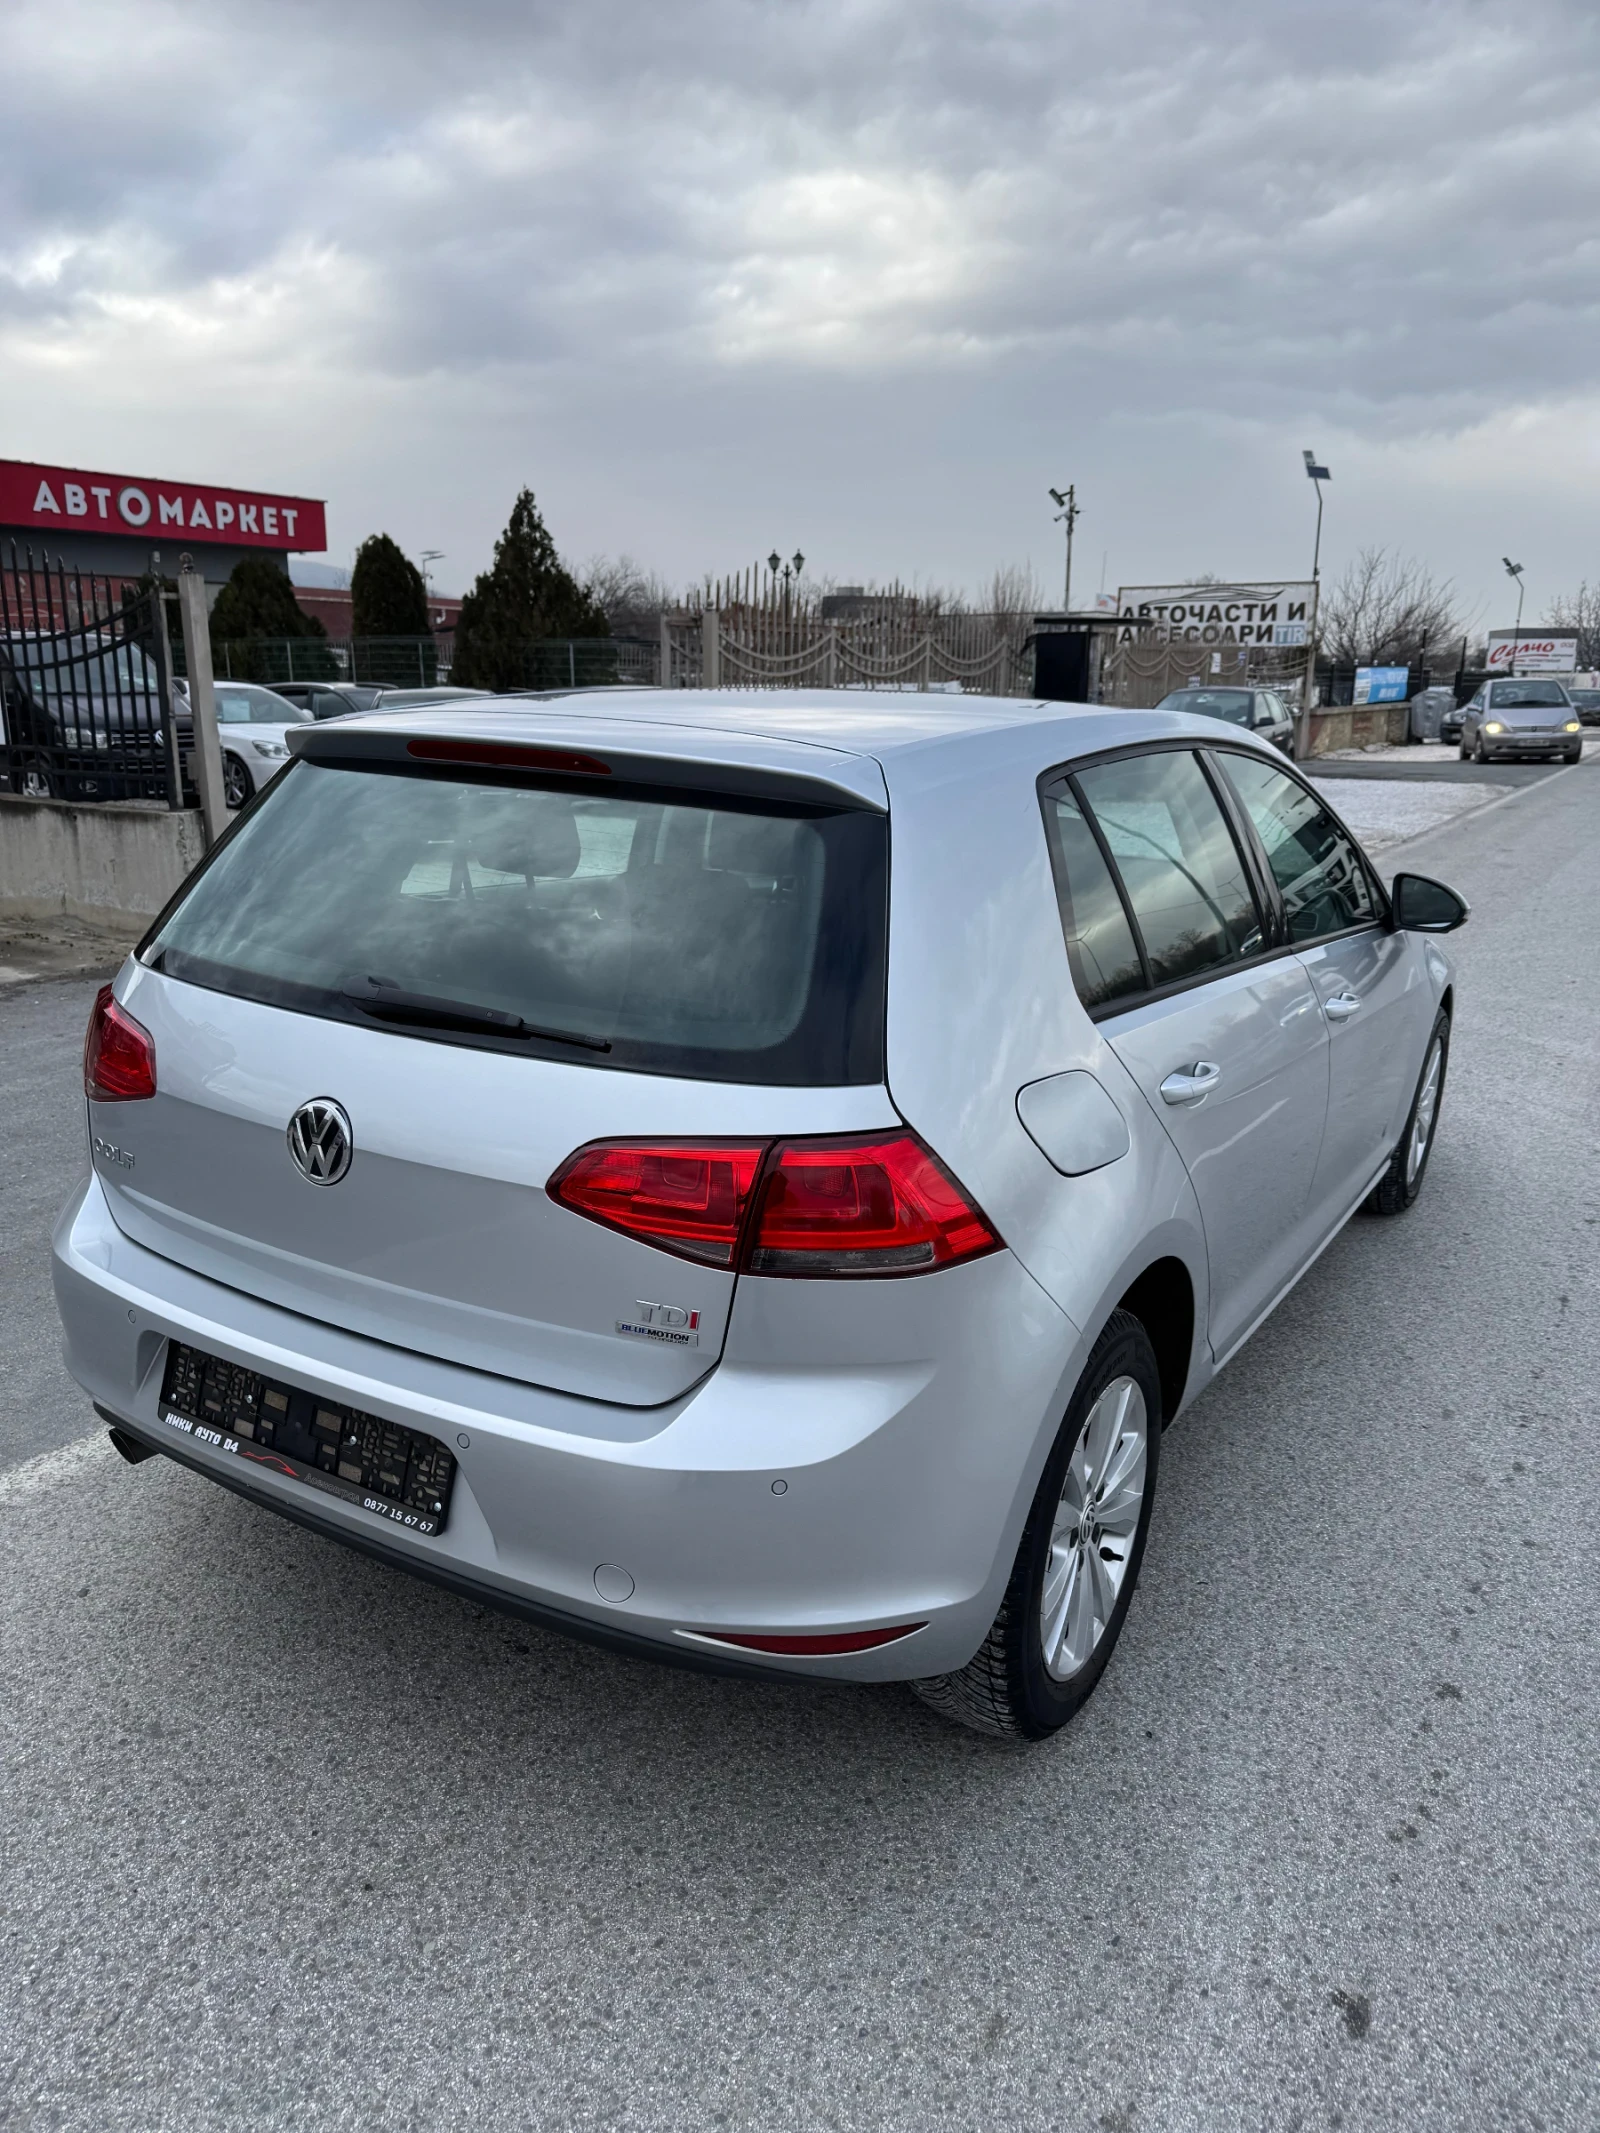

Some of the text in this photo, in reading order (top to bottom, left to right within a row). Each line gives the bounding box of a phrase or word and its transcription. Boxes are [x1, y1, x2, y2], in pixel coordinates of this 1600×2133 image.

[33, 480, 298, 536] АВТОМАРКЕТ
[1123, 602, 1306, 623] АВТОЧАСТИ И
[1276, 625, 1305, 644] TIR
[635, 1299, 701, 1331] TDI
[621, 1323, 690, 1341] BLUEMOTION
[165, 1412, 194, 1433] НИКИ
[363, 1497, 434, 1533] 0877 15 67 67
